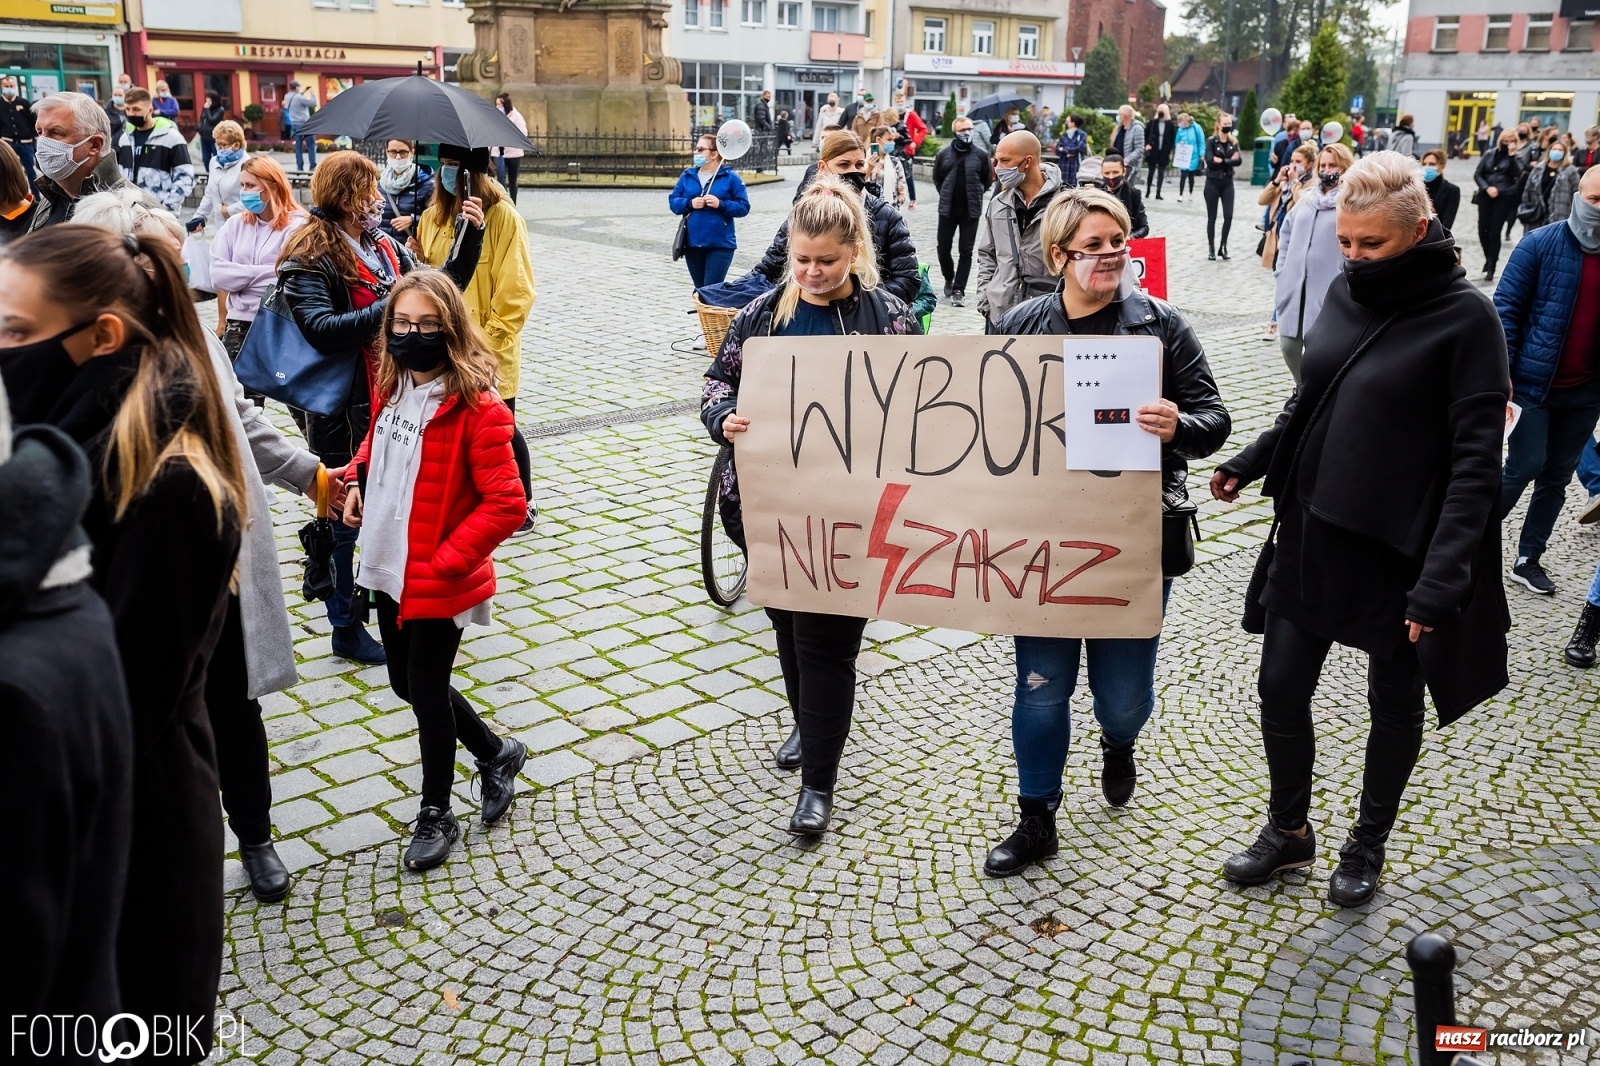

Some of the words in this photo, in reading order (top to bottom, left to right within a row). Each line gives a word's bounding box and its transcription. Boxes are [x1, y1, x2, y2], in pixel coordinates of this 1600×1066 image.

[250, 46, 346, 60] RESTAURACJA
[1009, 60, 1058, 73] ROSSMANN
[392, 429, 402, 442] do
[403, 435, 409, 446] it
[777, 515, 862, 592] NIE
[895, 519, 1131, 606] ZAKAZ
